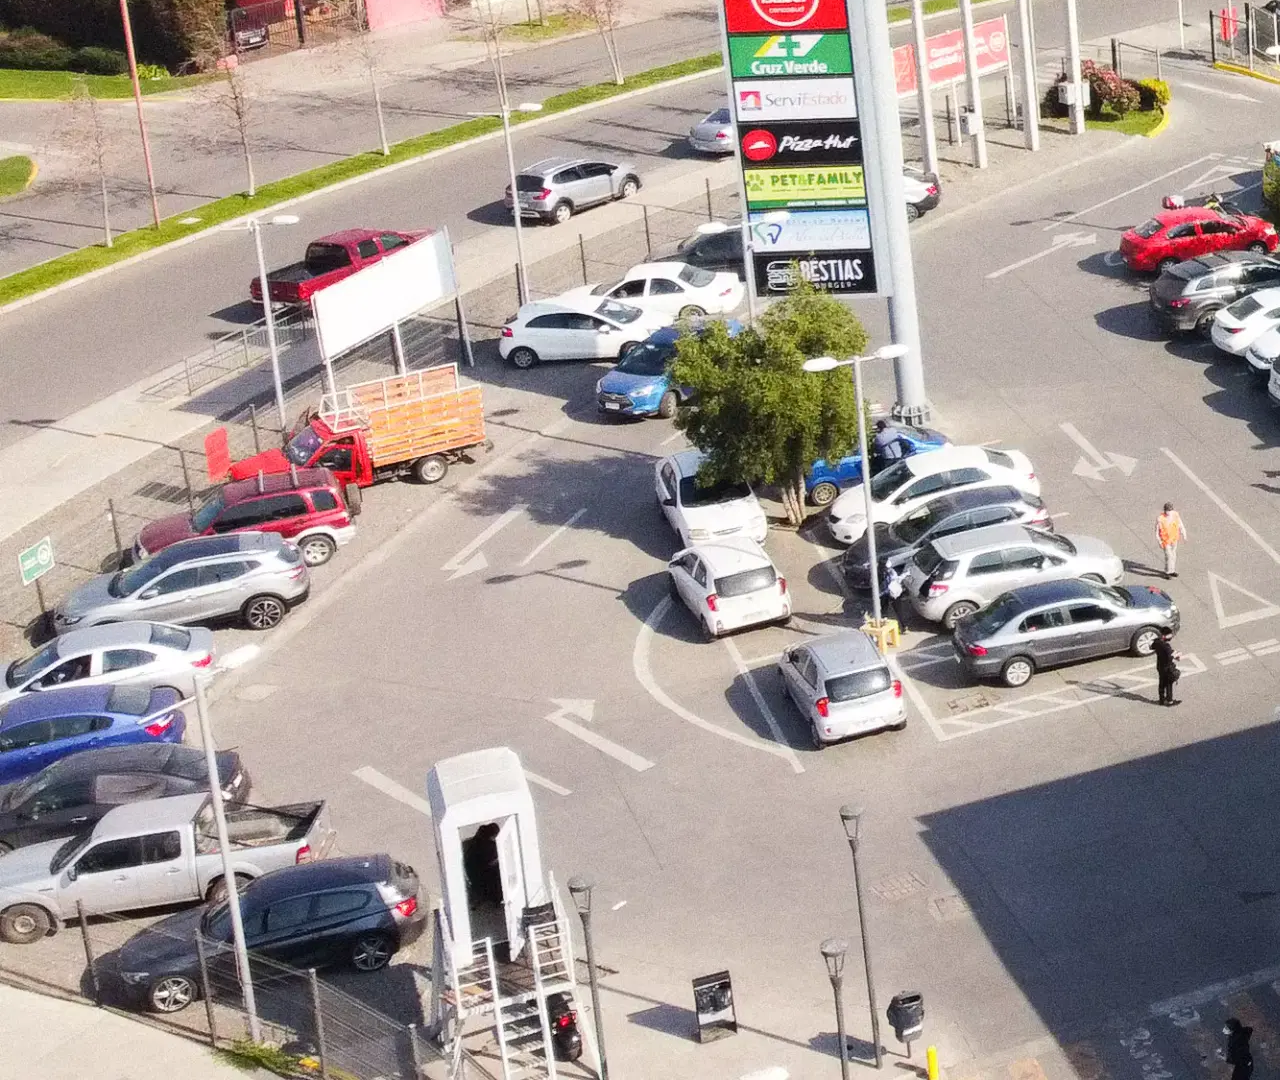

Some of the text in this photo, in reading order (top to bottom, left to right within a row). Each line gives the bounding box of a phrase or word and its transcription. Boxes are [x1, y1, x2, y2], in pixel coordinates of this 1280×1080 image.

[751, 59, 828, 75] Cruz Verde
[765, 91, 847, 107] ServiEstado
[778, 134, 859, 153] Pizza Hut
